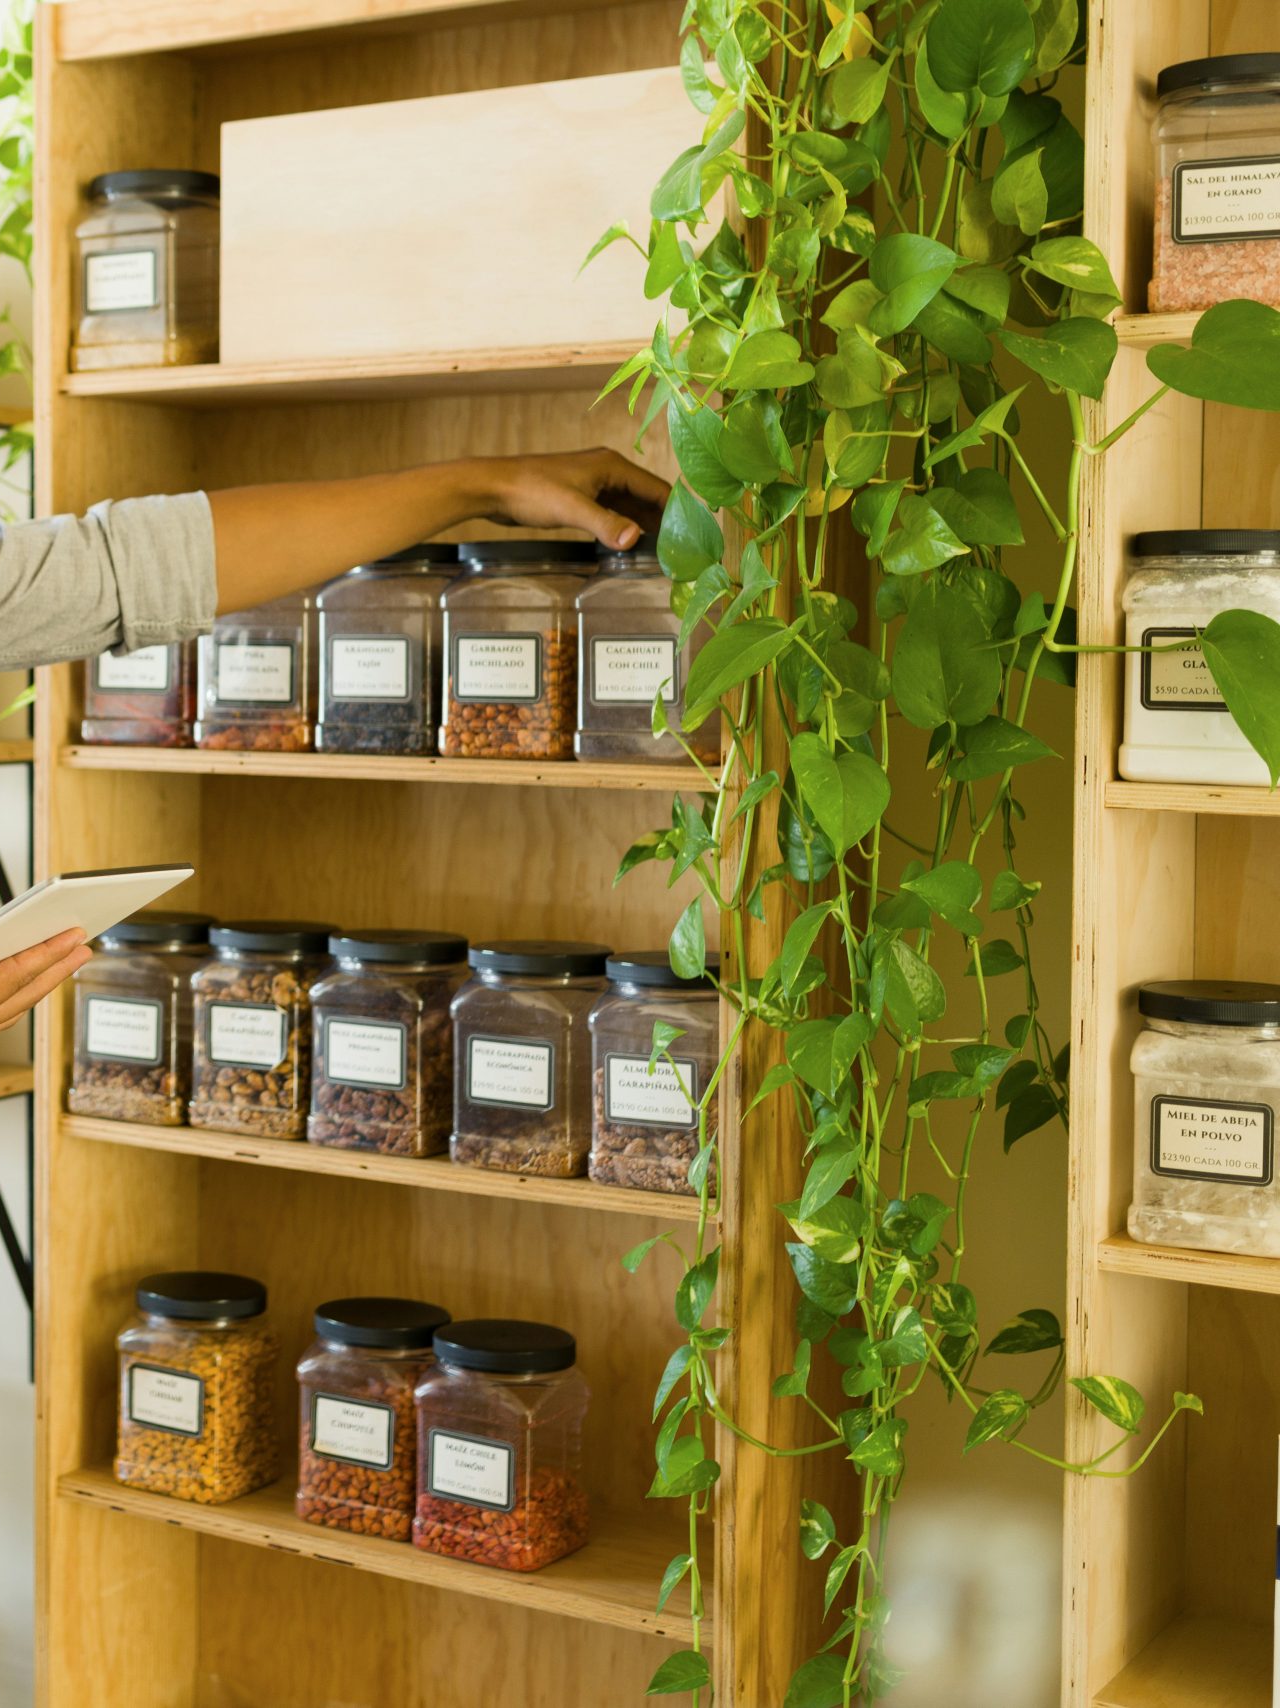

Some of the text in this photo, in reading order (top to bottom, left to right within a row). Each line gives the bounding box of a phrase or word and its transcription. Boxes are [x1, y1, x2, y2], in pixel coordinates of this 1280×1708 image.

[1186, 176, 1205, 185] SAL
[1208, 175, 1226, 184] DEL
[1207, 187, 1262, 198] EN GRANO
[1215, 214, 1245, 223] CADA
[1247, 211, 1265, 221] 100
[605, 645, 663, 655] CACAHUATE
[608, 660, 660, 670] CON CHILE
[1154, 685, 1178, 695] $5.90
[1180, 686, 1210, 695] CADA
[1167, 1109, 1258, 1127] MIEL DE ABEJA
[1180, 1128, 1243, 1142] EN POLVO
[1161, 1152, 1191, 1164] $23.90
[1193, 1156, 1222, 1167] CADA
[1224, 1159, 1242, 1169] 100
